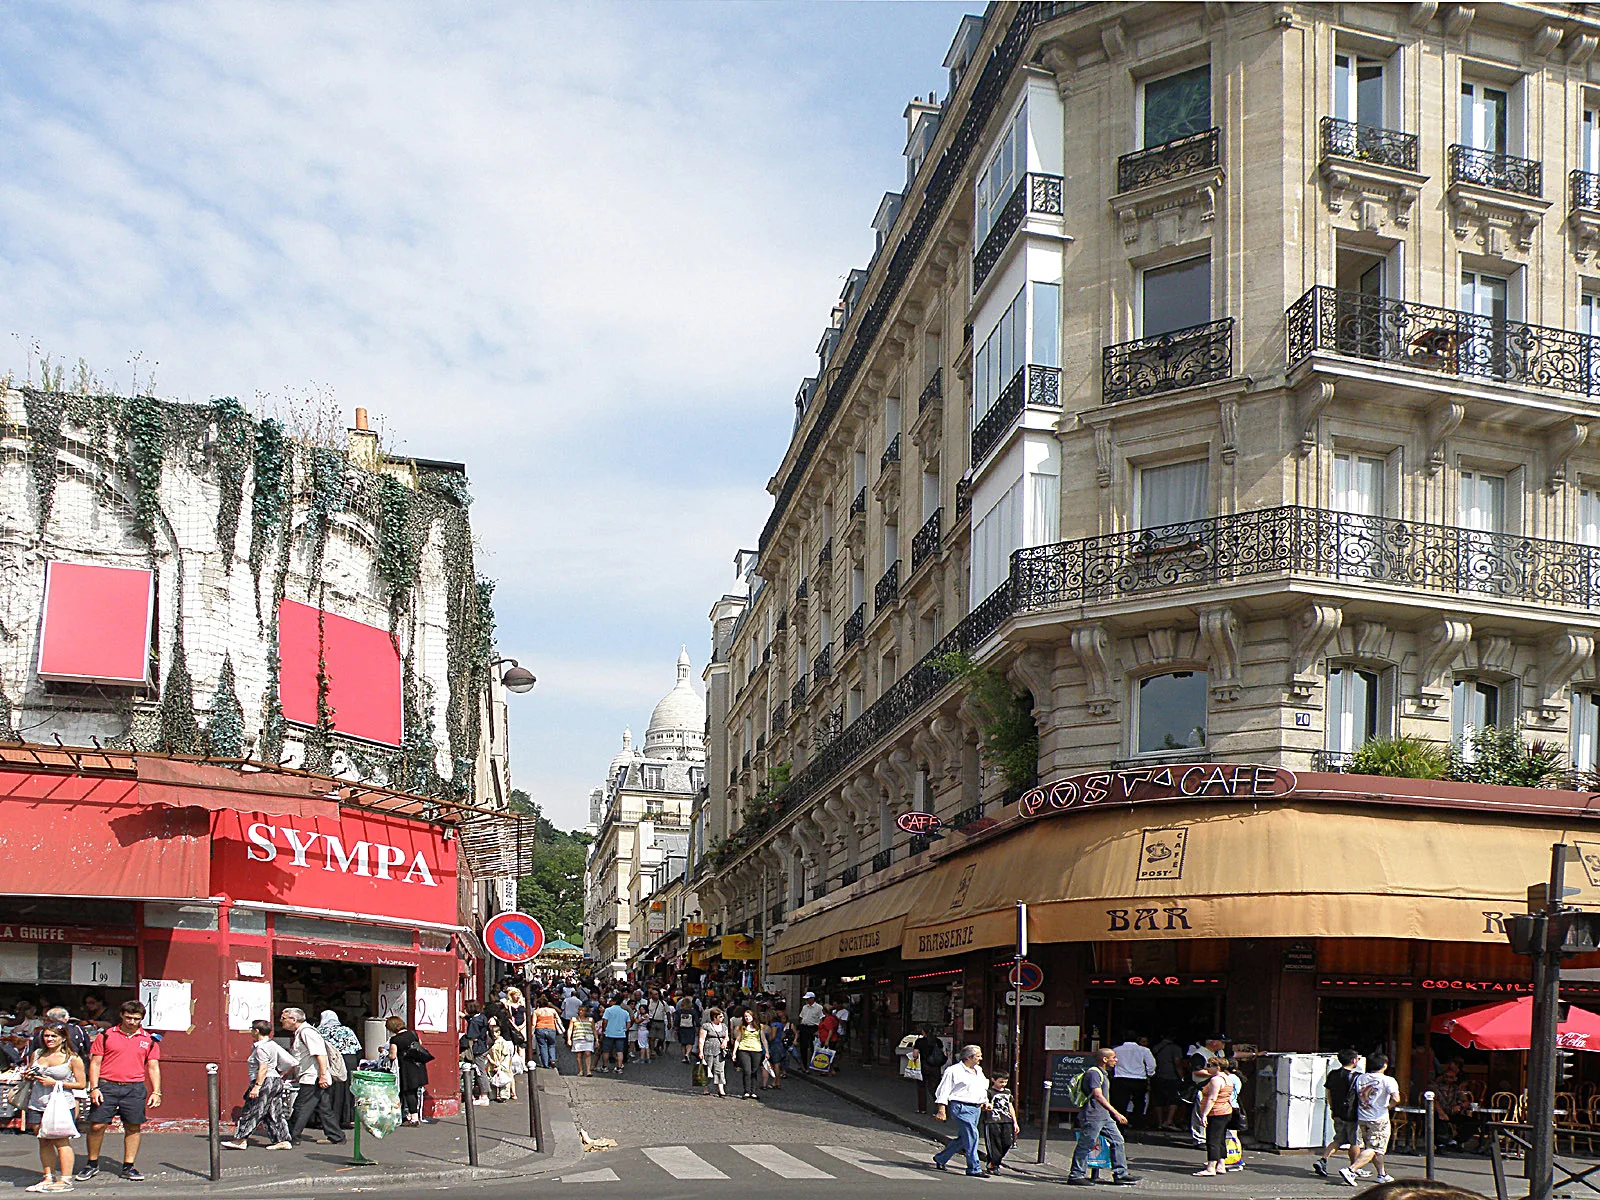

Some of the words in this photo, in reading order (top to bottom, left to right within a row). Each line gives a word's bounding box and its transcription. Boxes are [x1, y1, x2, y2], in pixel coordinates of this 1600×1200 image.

[1297, 713, 1310, 725] 70
[247, 822, 438, 887] SYMPA
[1106, 908, 1192, 931] BAR
[0, 926, 13, 937] A
[20, 927, 65, 940] GRIFFE
[918, 925, 975, 953] BRASSERIE
[1128, 976, 1180, 986] BAR
